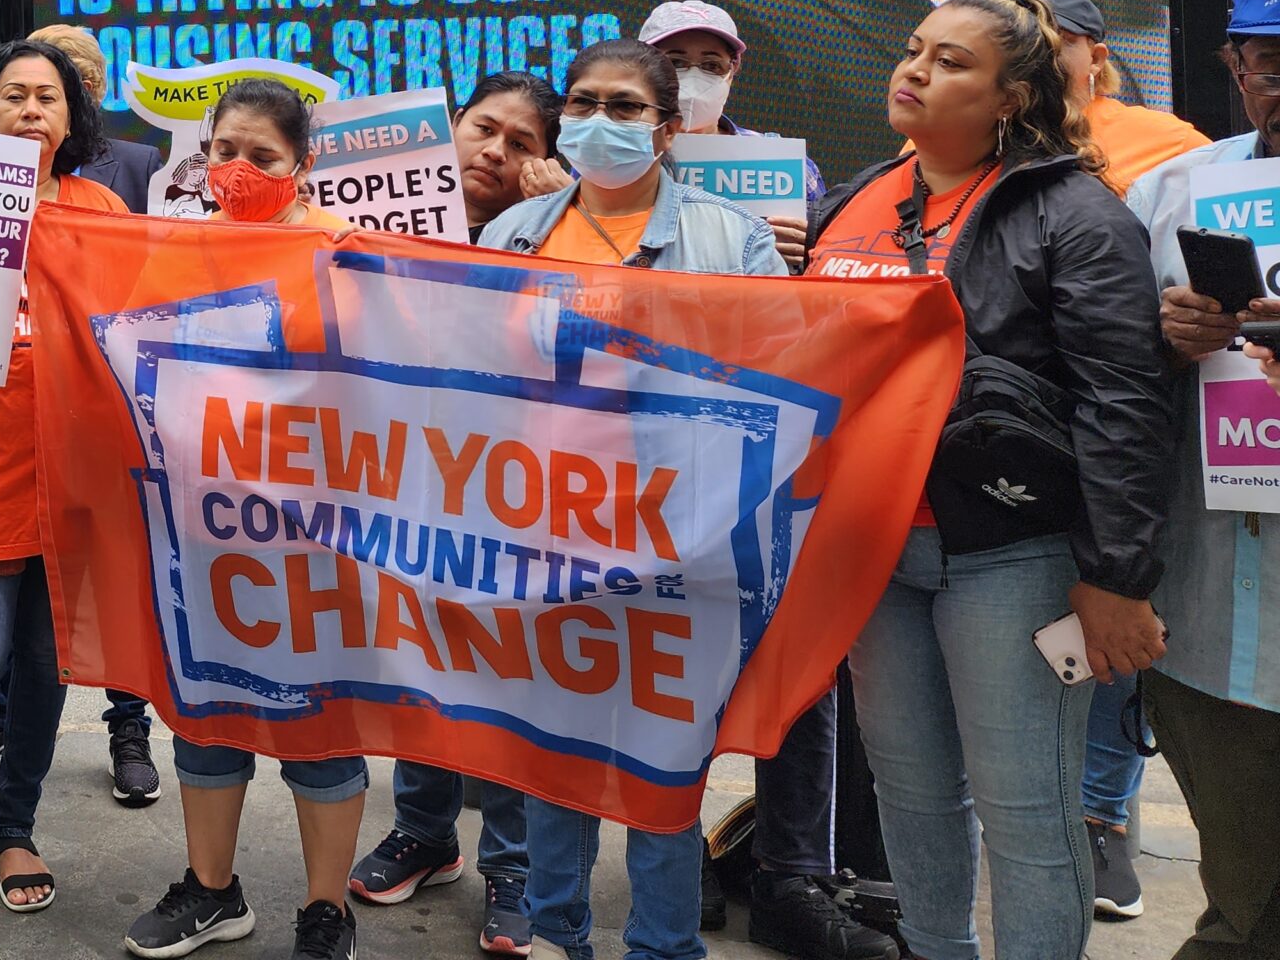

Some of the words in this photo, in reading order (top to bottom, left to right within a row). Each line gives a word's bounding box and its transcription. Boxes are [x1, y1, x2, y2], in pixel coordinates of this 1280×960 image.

[153, 85, 209, 103] MAKE
[343, 124, 410, 152] NEED
[417, 119, 439, 142] A
[311, 165, 457, 207] EOPLE'S
[716, 169, 794, 196] NEED
[1212, 199, 1275, 230] WE
[821, 257, 879, 279] NEW
[201, 396, 408, 502] NEW
[422, 426, 681, 562] YORK
[202, 492, 642, 604] COMMUNITIES
[654, 574, 686, 600] FOR
[209, 554, 695, 724] CHANGE
